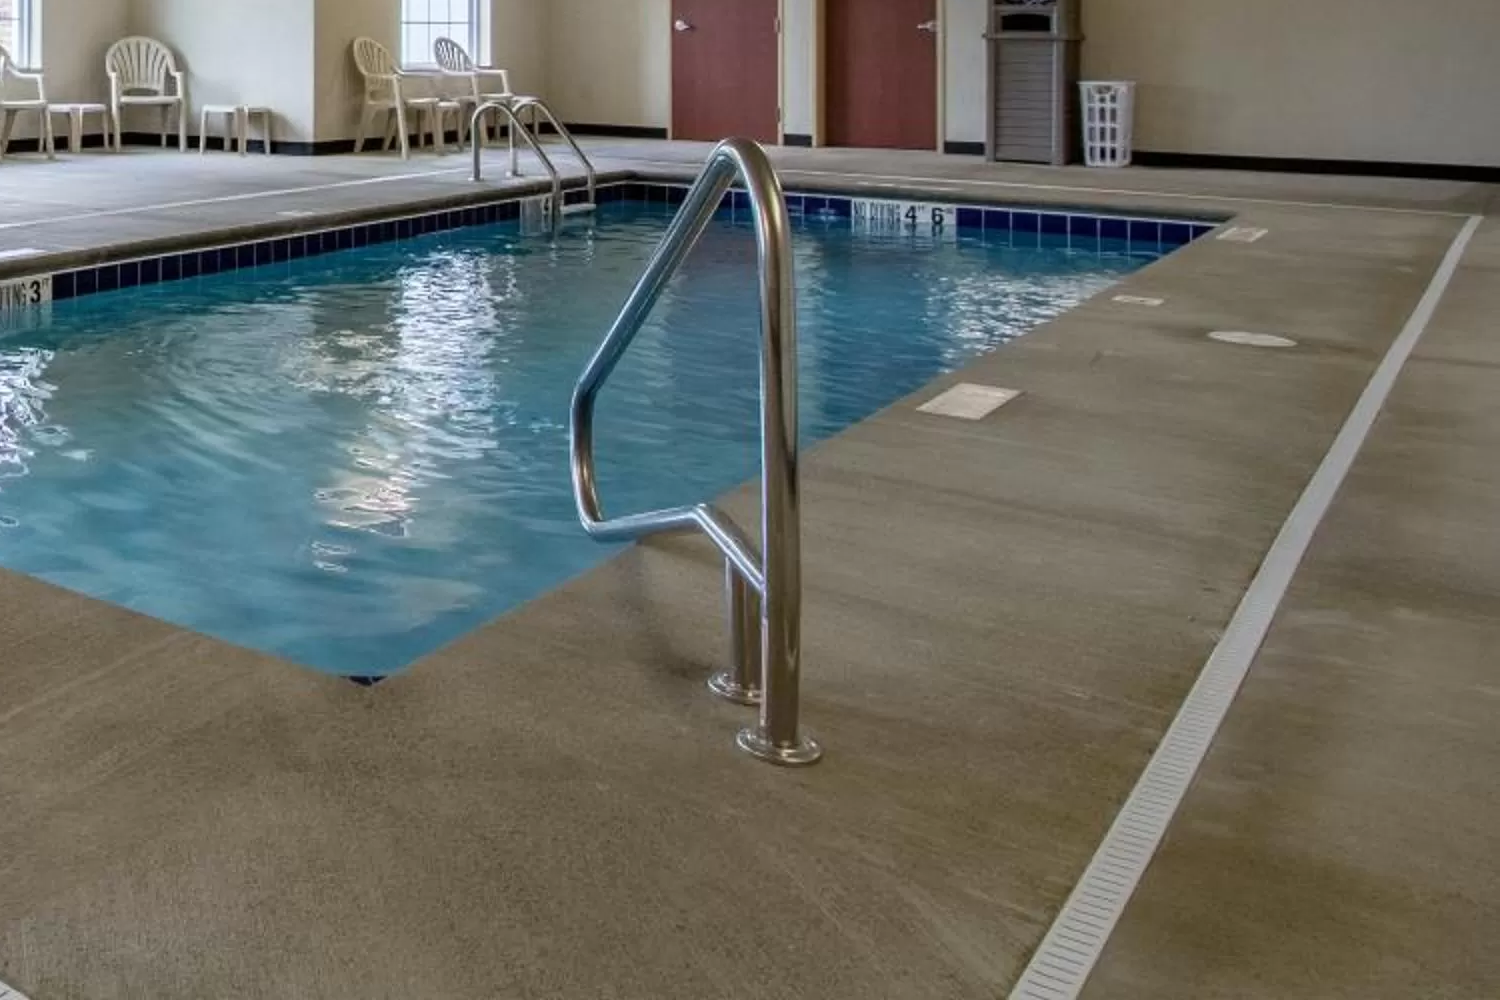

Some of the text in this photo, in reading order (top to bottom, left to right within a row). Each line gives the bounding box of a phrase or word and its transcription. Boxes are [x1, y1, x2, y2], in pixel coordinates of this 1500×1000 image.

[905, 206, 917, 223] 4
[931, 207, 944, 225] 6
[30, 280, 41, 304] 3
